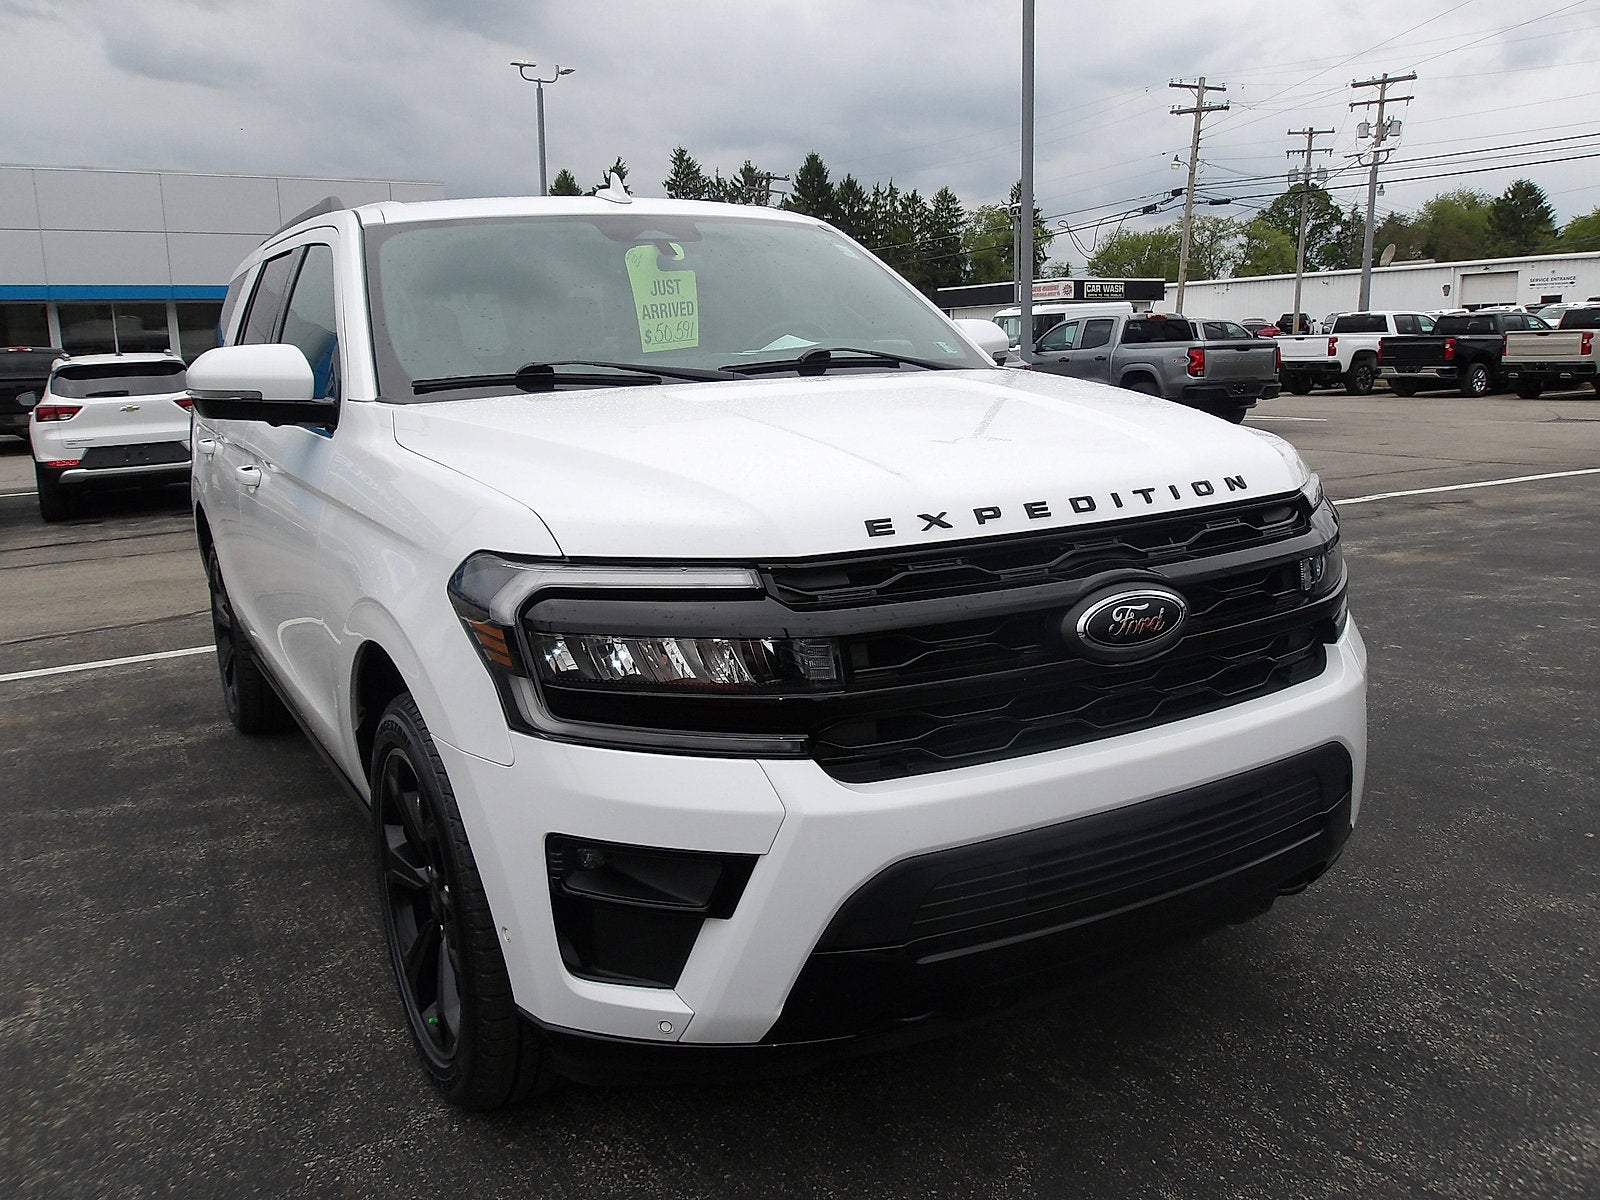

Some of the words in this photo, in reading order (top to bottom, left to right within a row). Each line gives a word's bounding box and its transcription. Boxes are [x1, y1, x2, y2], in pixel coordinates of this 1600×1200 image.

[650, 279, 681, 296] JUST
[1086, 285, 1100, 293] CAR
[1103, 284, 1124, 293] WASH
[642, 301, 694, 320] ARRIVED
[864, 474, 1248, 538] EXPEDITION
[1108, 602, 1166, 636] Ford
